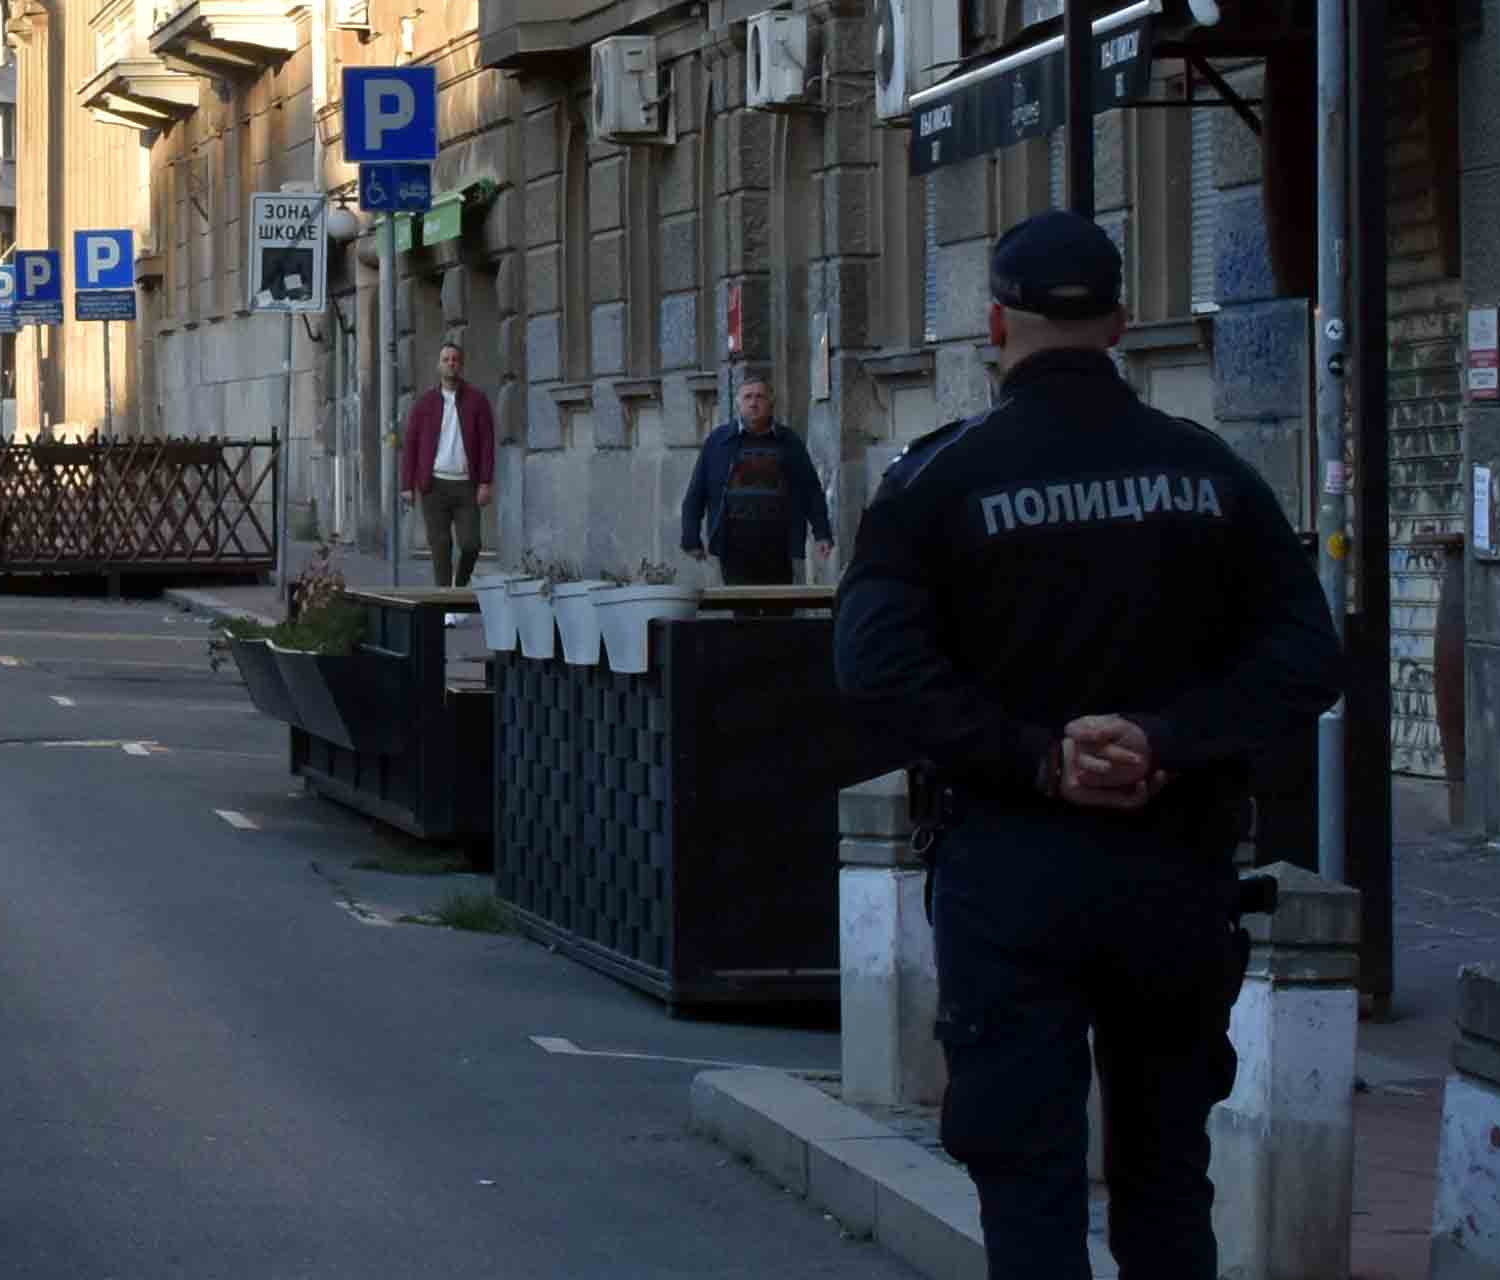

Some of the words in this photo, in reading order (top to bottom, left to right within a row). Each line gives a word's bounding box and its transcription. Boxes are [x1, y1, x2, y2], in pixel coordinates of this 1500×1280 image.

[363, 78, 416, 152] P
[257, 224, 319, 241] ШКОЛЕ
[263, 203, 313, 220] ЗОНА
[24, 256, 51, 296] P
[87, 236, 120, 282] P
[980, 472, 1225, 537] ПОЛИЦИЈА
